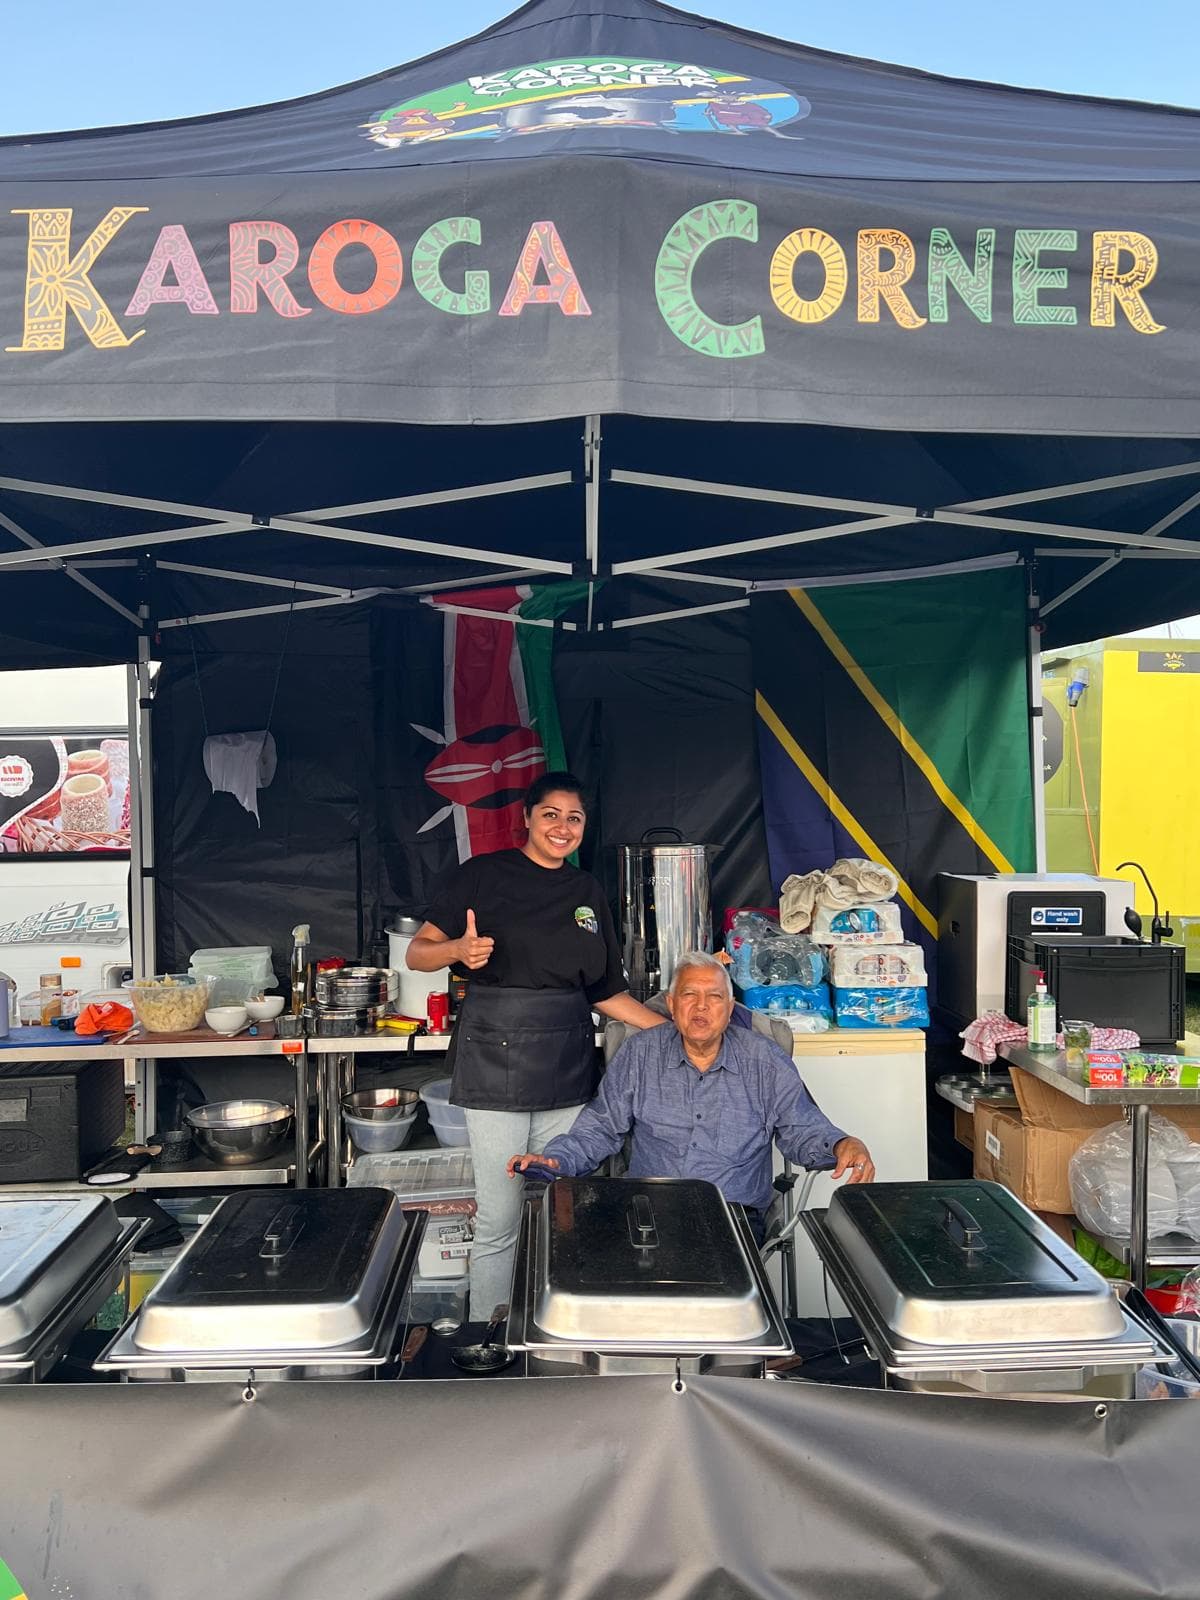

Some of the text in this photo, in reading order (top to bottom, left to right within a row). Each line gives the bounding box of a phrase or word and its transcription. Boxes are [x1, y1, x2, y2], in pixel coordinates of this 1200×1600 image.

[467, 63, 714, 88] KAROGA
[473, 74, 719, 96] CORNER
[4, 198, 1169, 359] KAROGA CORNER
